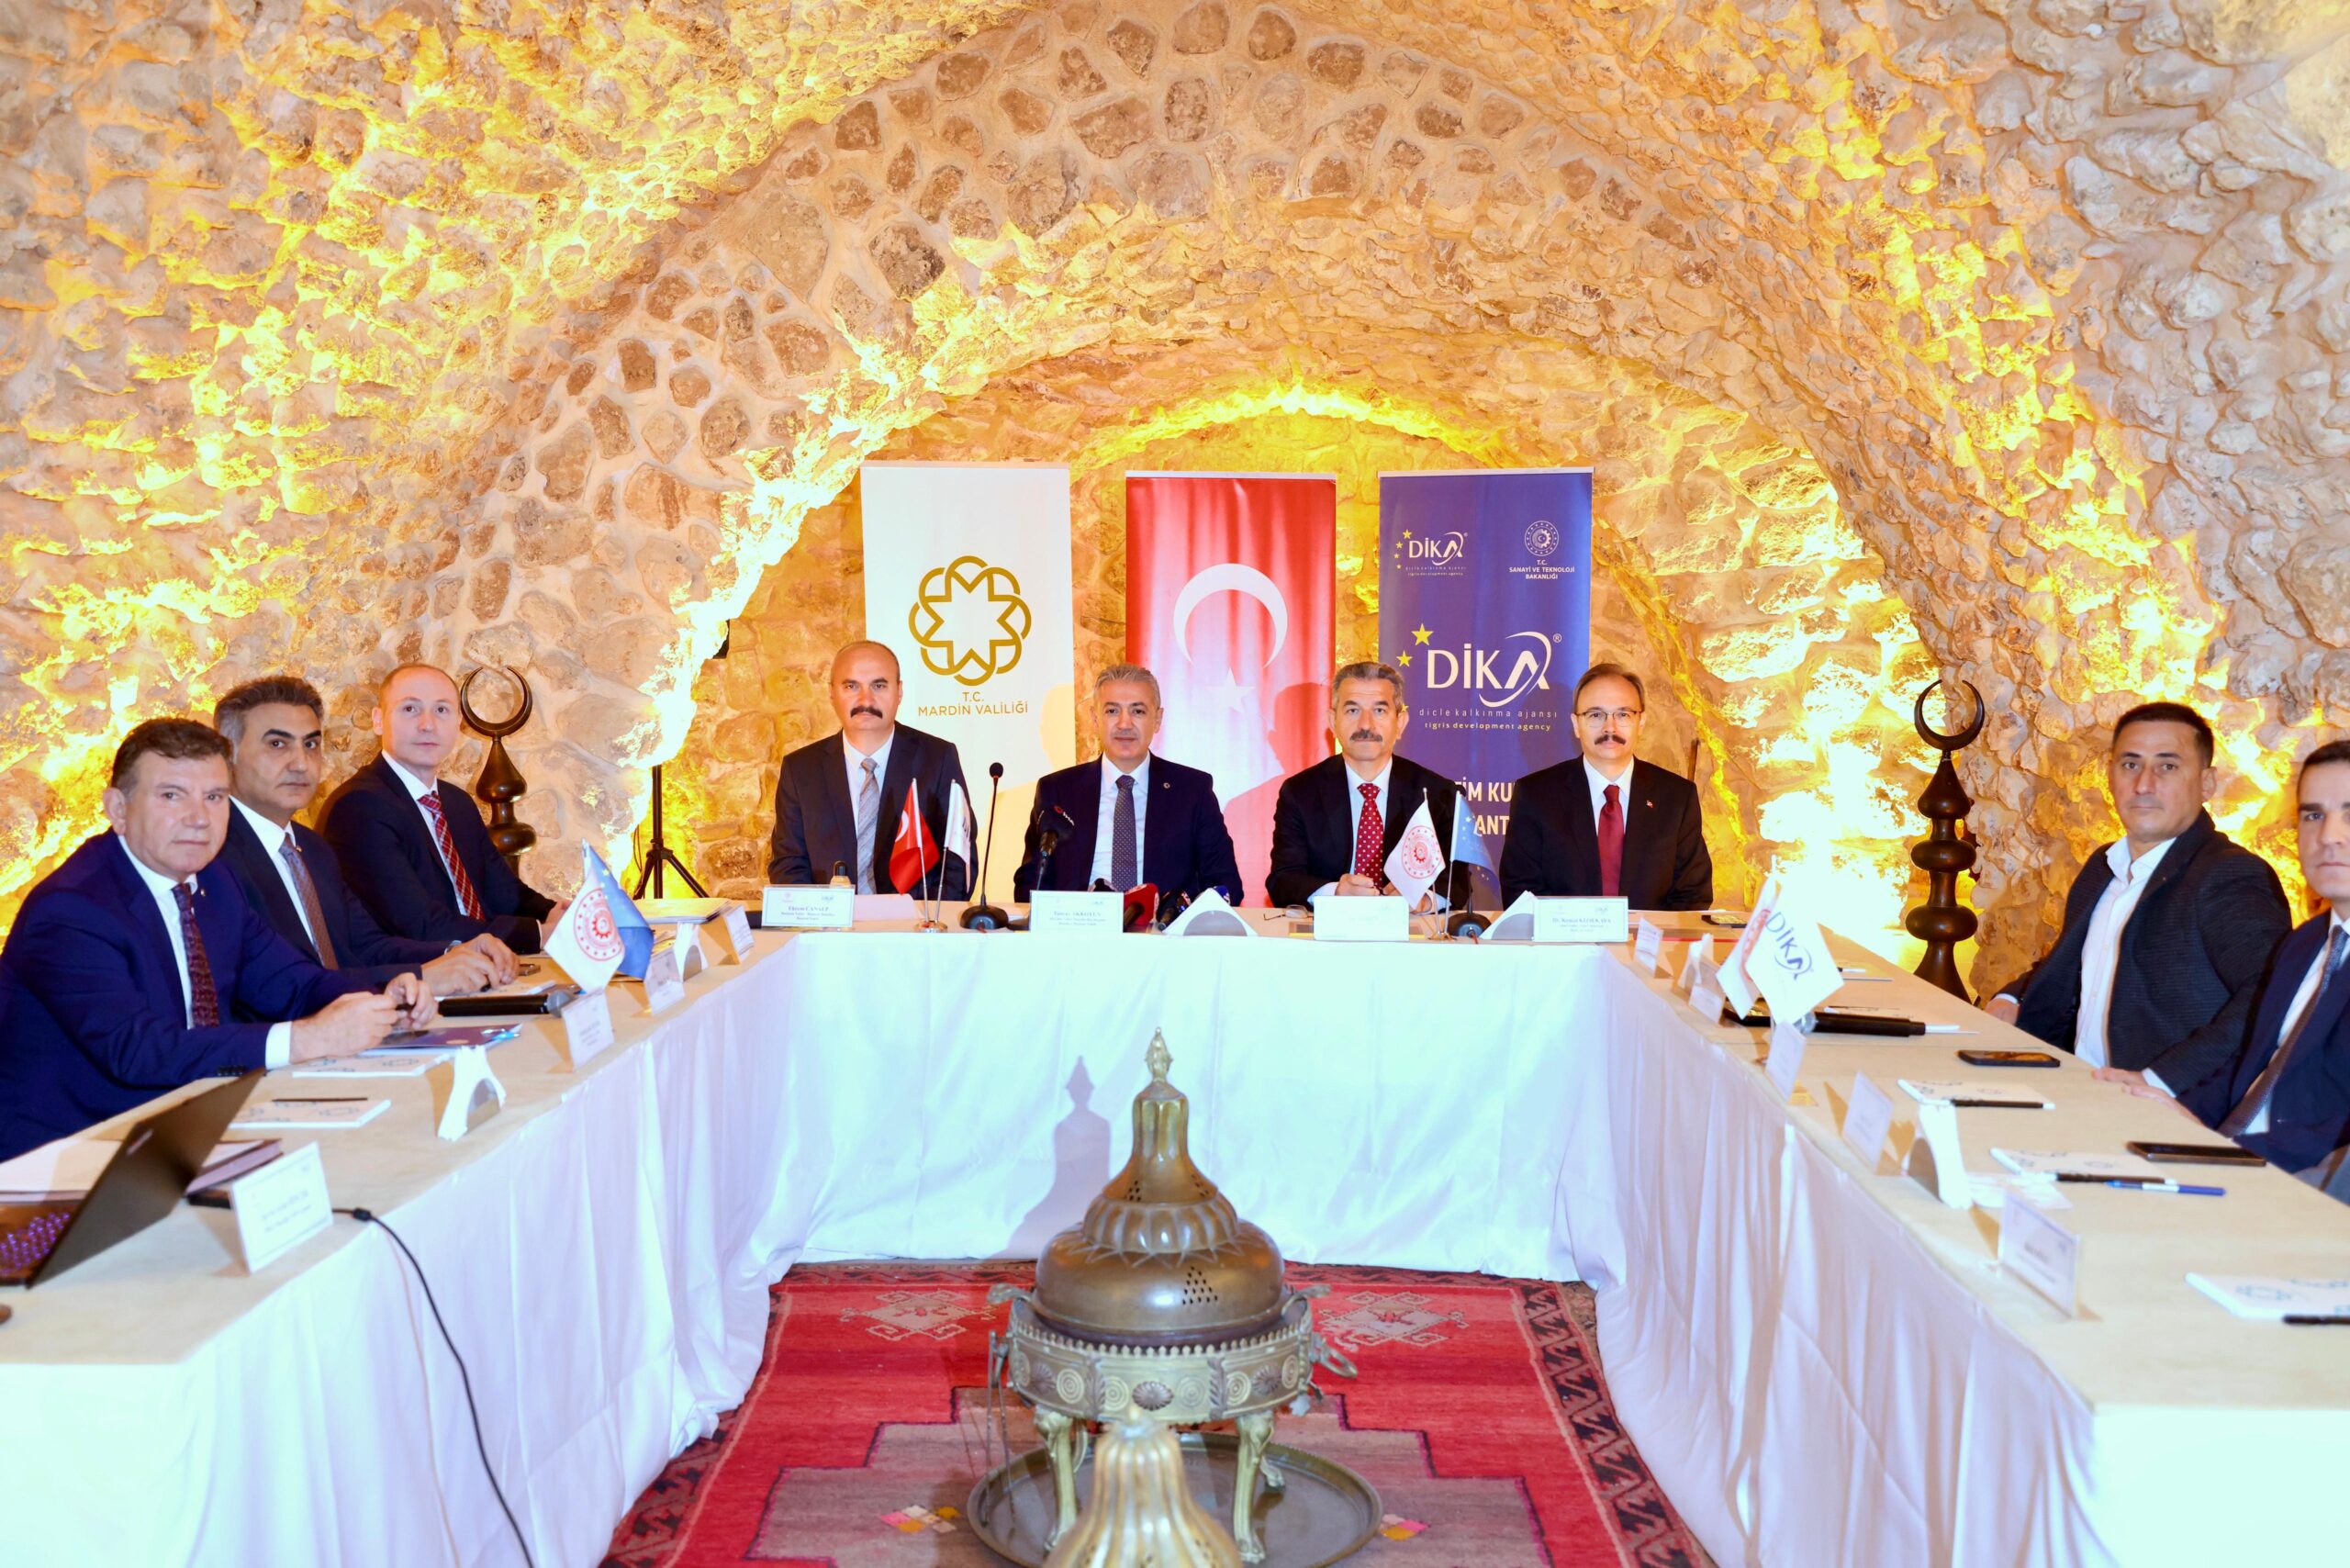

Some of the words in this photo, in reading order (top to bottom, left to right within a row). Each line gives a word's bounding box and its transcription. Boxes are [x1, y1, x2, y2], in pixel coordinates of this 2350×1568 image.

[1408, 535, 1463, 561] DİKA
[1427, 639, 1551, 699] DİKA
[962, 691, 984, 702] T.C.
[918, 703, 971, 716] MARDİN
[975, 700, 1028, 714] VALİLİĞİ
[1419, 708, 1450, 717] dicle
[1455, 708, 1511, 717] kalkınma
[1517, 709, 1557, 719] ajansı
[1425, 722, 1450, 730] tigris
[1452, 722, 1515, 731] development
[1517, 723, 1551, 732] agency
[1488, 782, 1514, 802] KU
